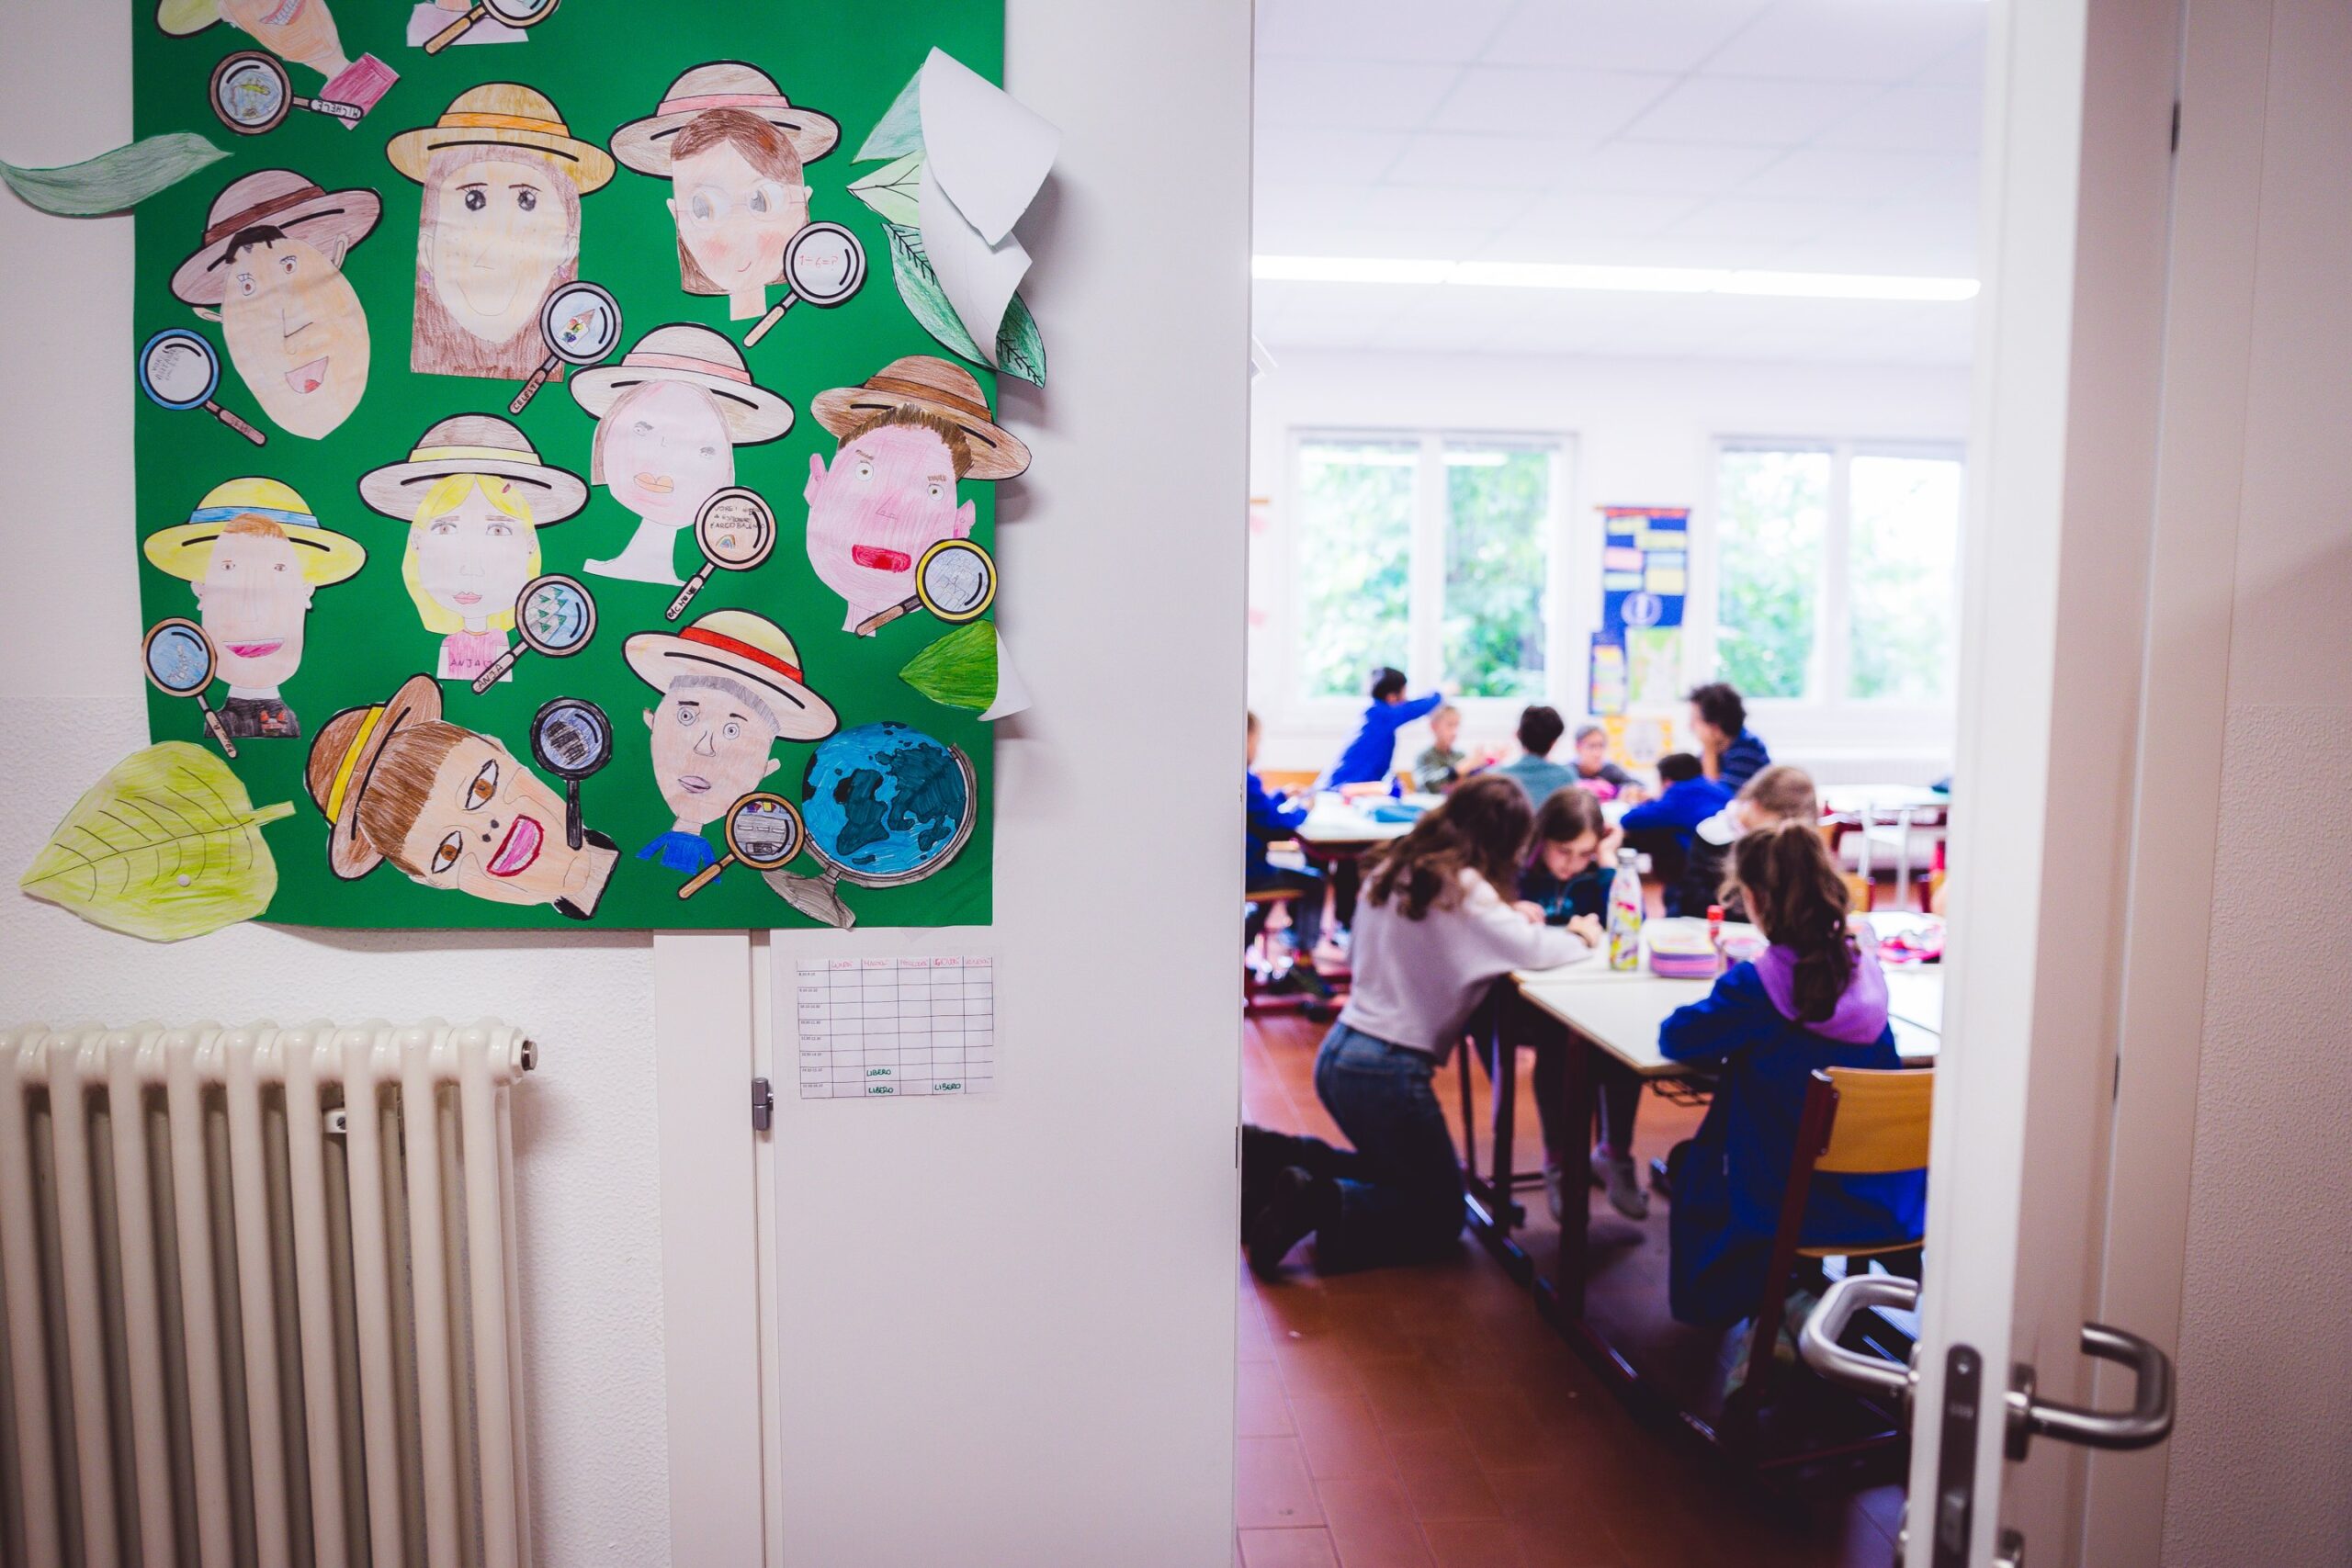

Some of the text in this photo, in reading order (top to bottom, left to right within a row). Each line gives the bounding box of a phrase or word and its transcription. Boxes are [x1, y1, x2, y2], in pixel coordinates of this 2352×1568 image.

[512, 378, 542, 411] CELESTE
[449, 659, 481, 668] ANJA
[477, 663, 504, 690] ANJA
[866, 1068, 891, 1077] LIBERO
[868, 1086, 894, 1094] LIBERO
[934, 1082, 961, 1091] LIBERO
